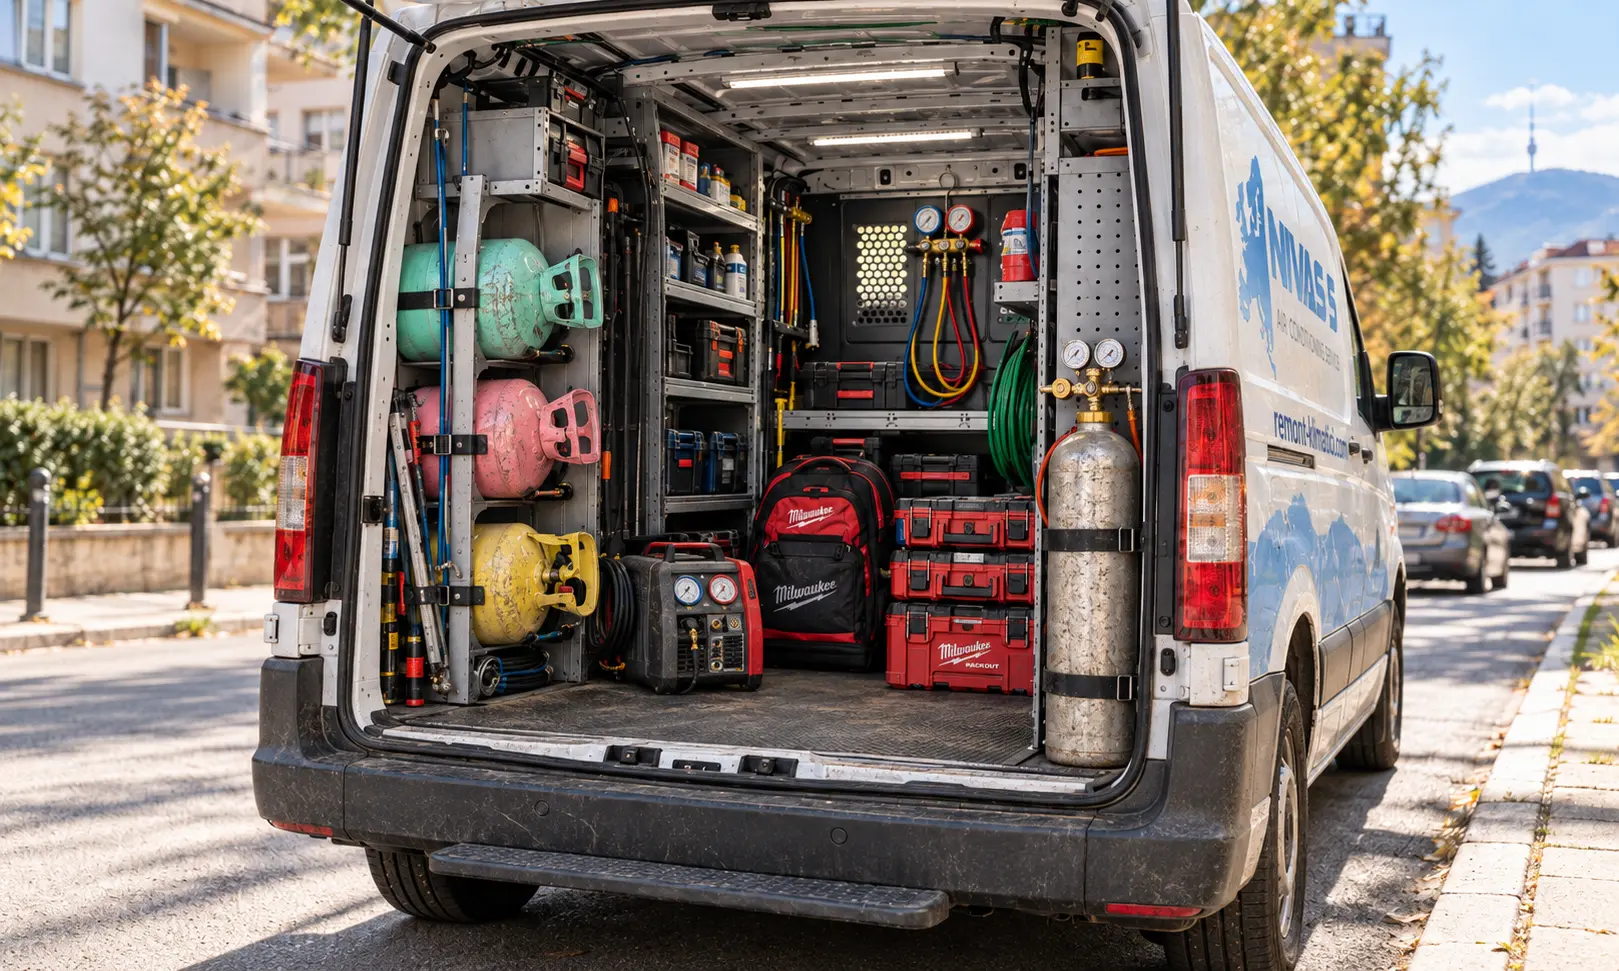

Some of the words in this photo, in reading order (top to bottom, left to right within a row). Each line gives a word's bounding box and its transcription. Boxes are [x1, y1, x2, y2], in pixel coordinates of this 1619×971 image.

[773, 580, 838, 605] Milwaukee
[937, 640, 992, 660] Milwaukee
[965, 662, 1000, 670] PACKOUT
